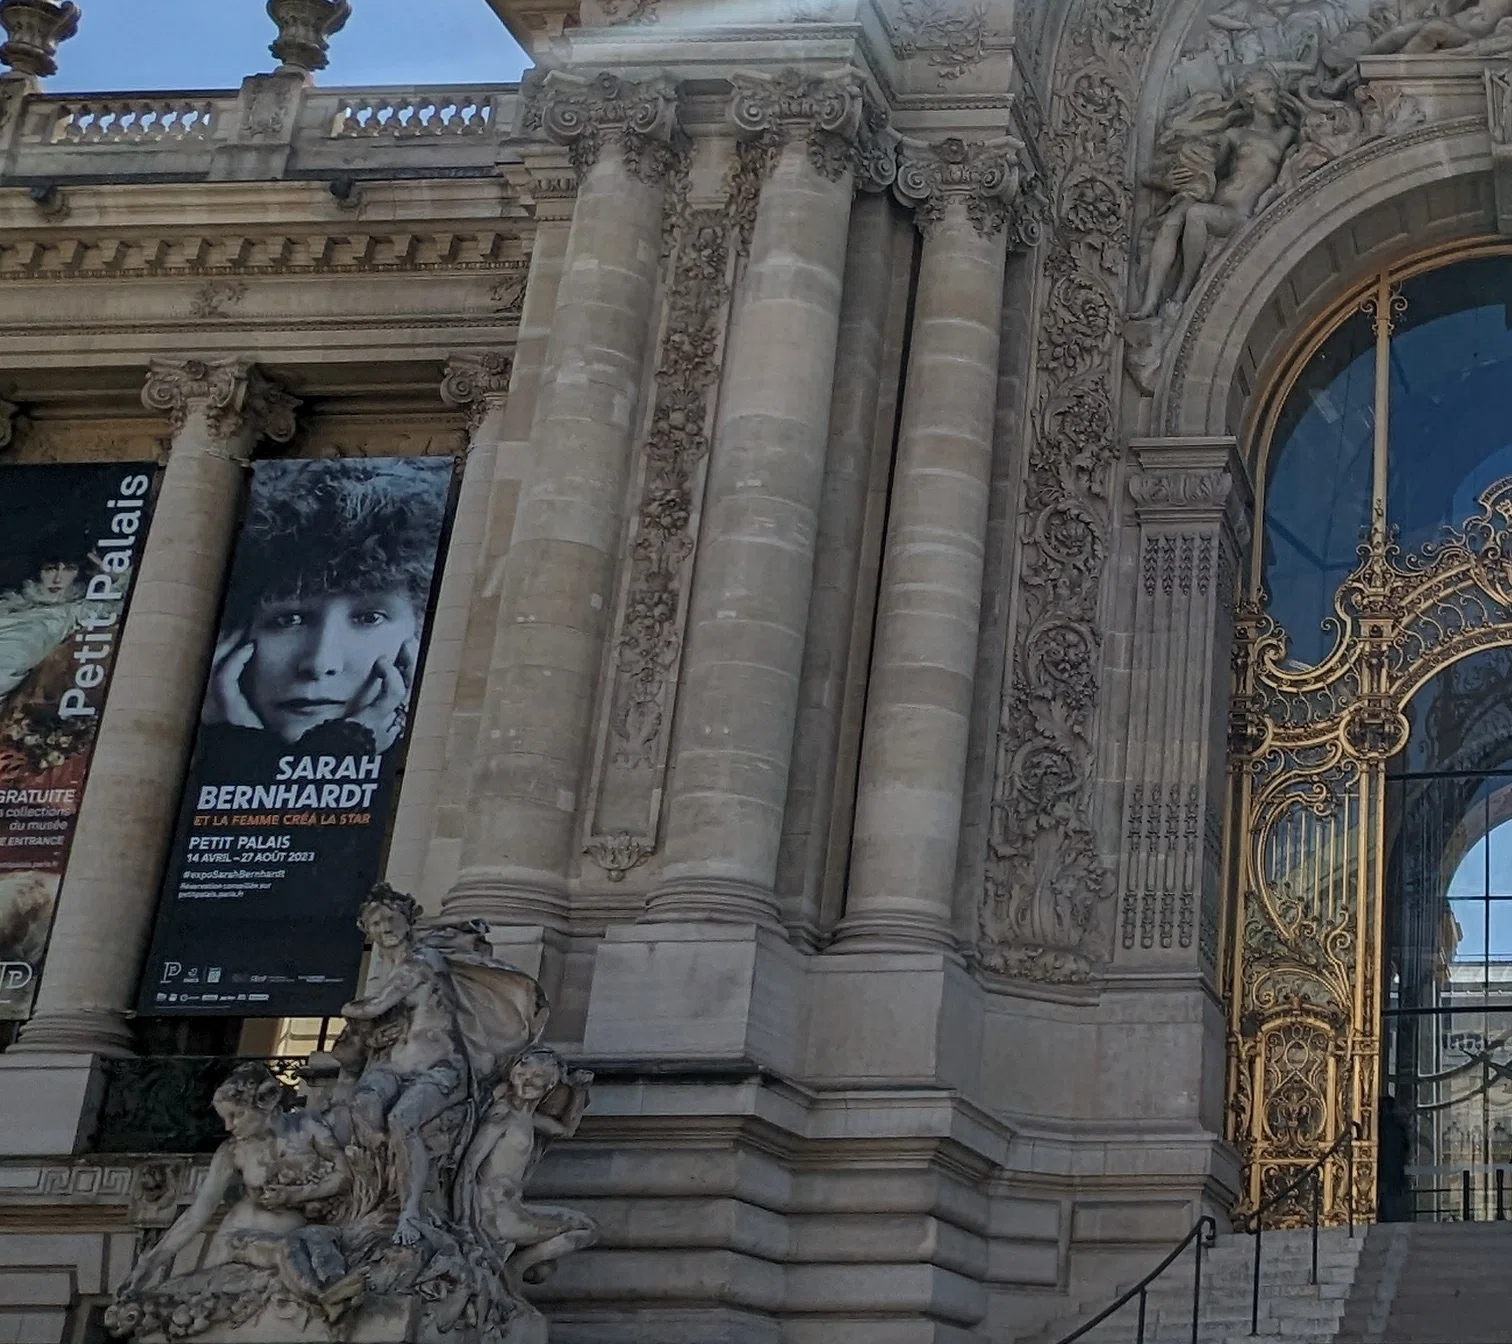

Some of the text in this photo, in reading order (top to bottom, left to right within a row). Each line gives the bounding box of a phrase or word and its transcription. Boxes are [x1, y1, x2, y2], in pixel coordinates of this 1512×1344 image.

[58, 474, 149, 720] Petit Palais
[276, 755, 382, 780] SARAH
[0, 789, 76, 804] GRATUITE
[197, 783, 378, 810] BERNHARDT
[6, 806, 71, 817] collections
[9, 819, 68, 831] du musée
[194, 812, 371, 826] ET LA FEMME CRÉA LA STAR
[8, 836, 65, 846] ENTRANCE
[188, 835, 291, 850] PETIT PALAIS
[187, 853, 199, 863] 14
[201, 853, 232, 863] AVRIL
[240, 853, 254, 862] 27
[254, 850, 287, 862] AOÛT
[287, 852, 315, 862] 2023
